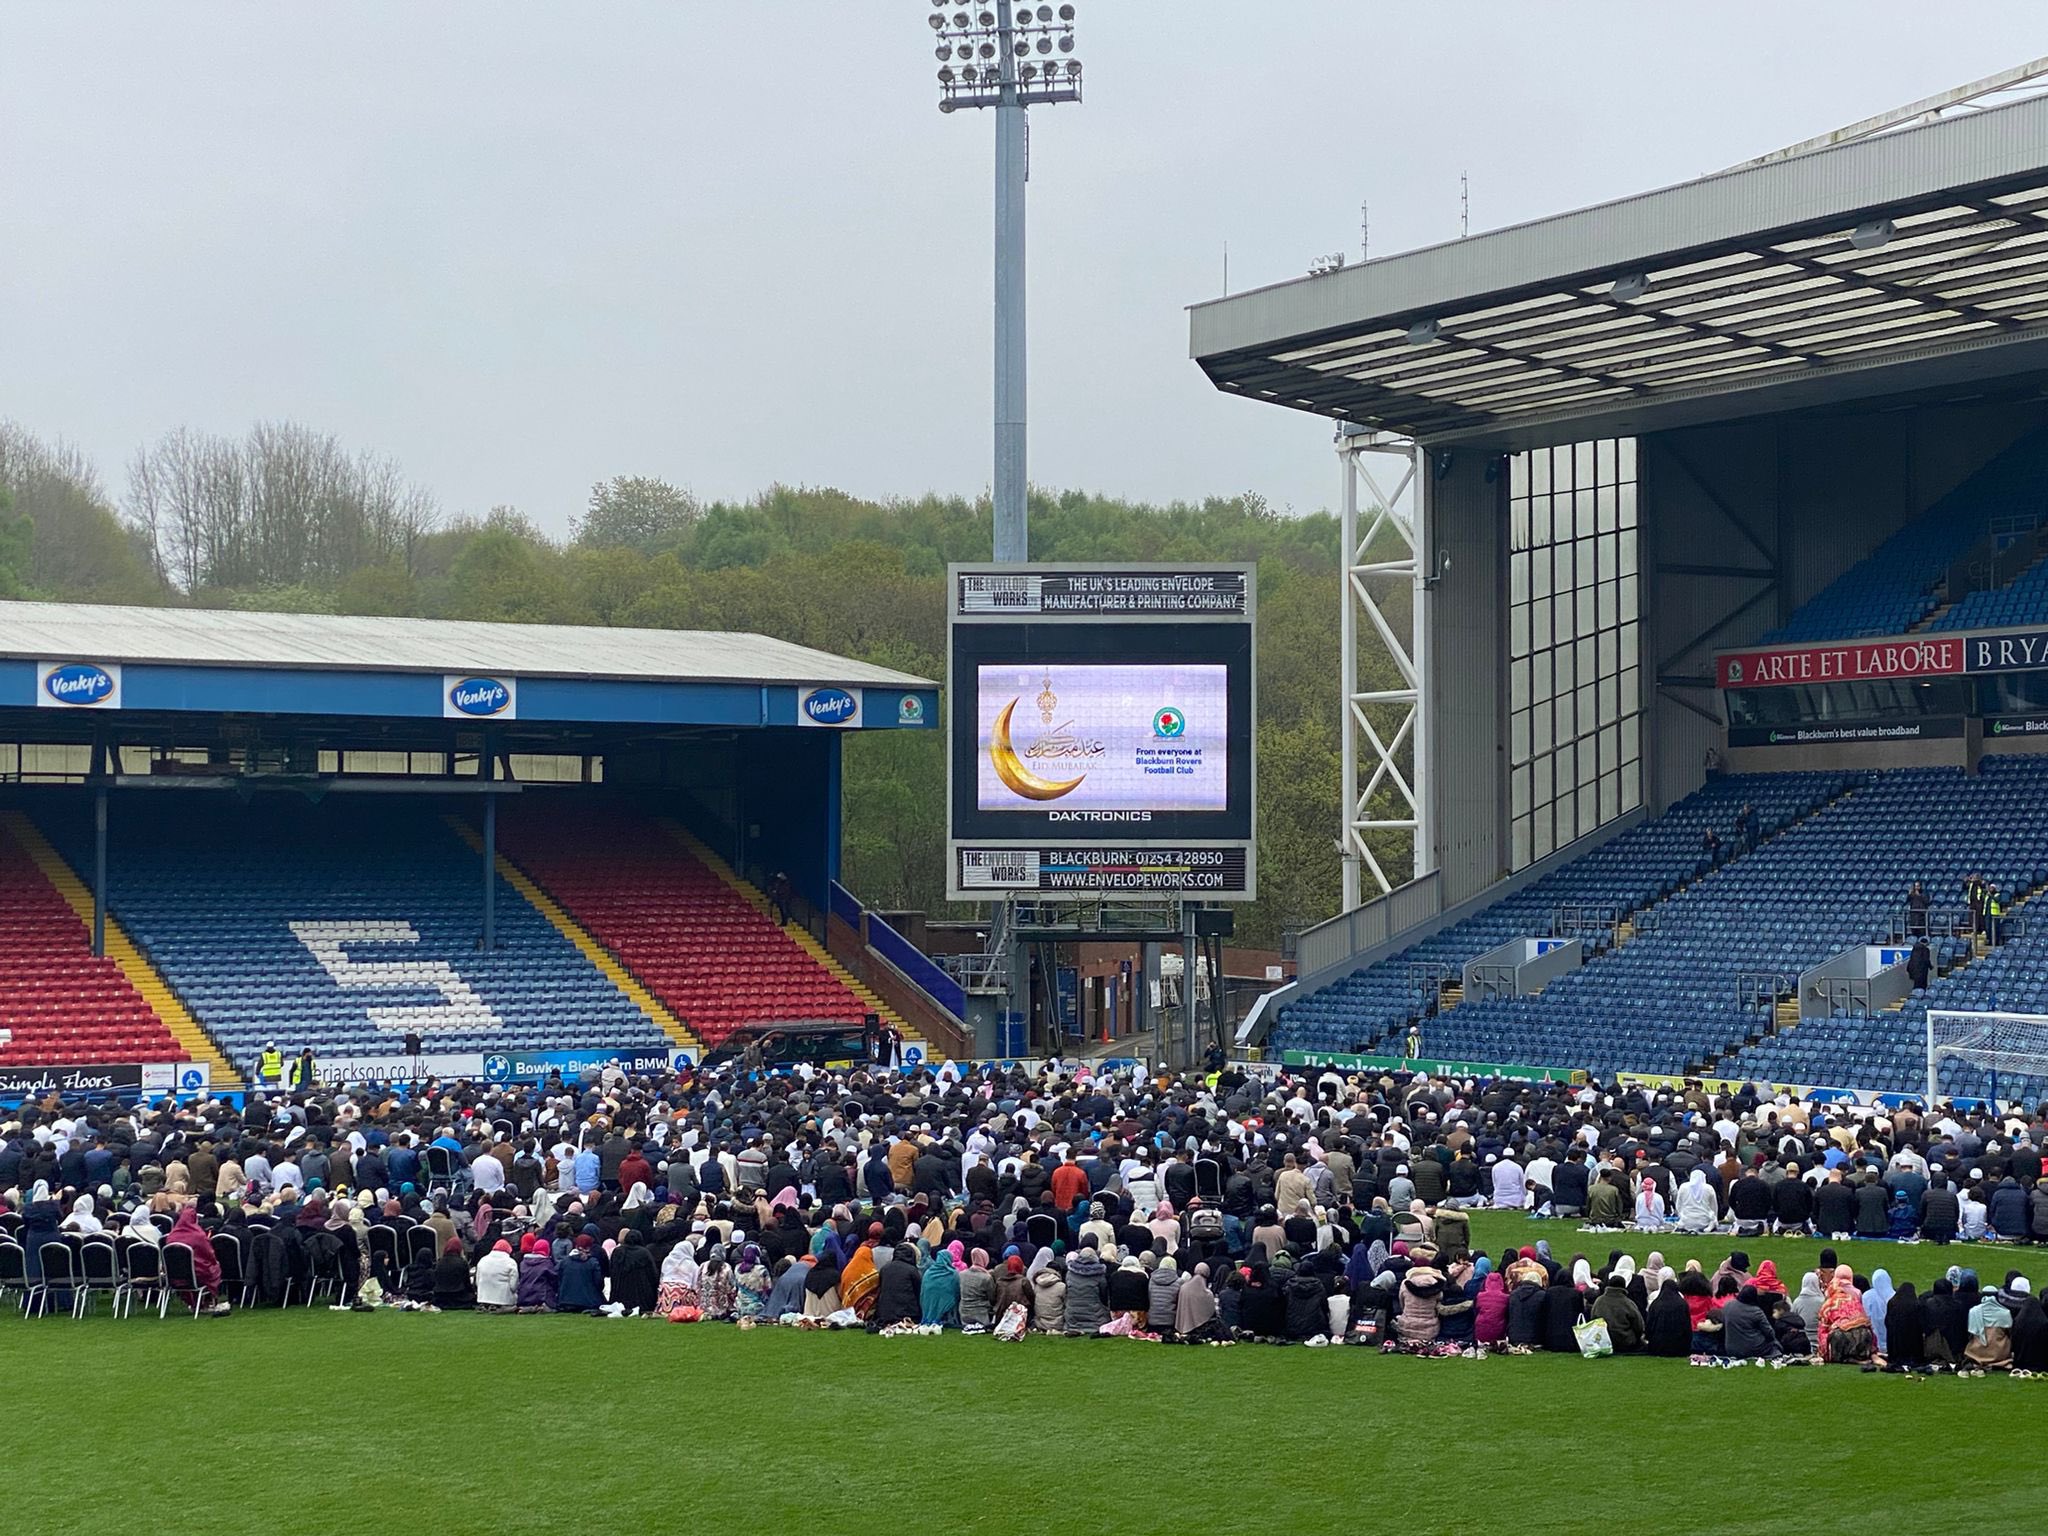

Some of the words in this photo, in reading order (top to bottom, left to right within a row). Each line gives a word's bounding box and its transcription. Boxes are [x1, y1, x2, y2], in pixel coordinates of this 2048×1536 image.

[967, 577, 984, 591] THE
[985, 577, 1028, 591] ENVELOPE
[1067, 577, 1087, 591] THE
[1089, 577, 1112, 591] UK'S
[1115, 577, 1159, 591] LEADING
[1161, 577, 1214, 591] ENVELOPE
[992, 591, 1028, 606] WORKS
[1044, 594, 1126, 609] MANUFACTURER
[1128, 594, 1136, 609] &
[1138, 594, 1185, 609] PRINTING
[1187, 594, 1238, 609] COMPANY
[1754, 653, 1812, 681] ARTE
[1820, 651, 1848, 676] ET
[1856, 644, 1953, 674] LABORE
[52, 674, 107, 695] Venky's
[456, 687, 503, 707] Venky's
[809, 697, 851, 716] Venky's
[1797, 729, 1839, 740] Blackburn's
[1840, 727, 1856, 738] best
[1857, 726, 1877, 737] value
[1878, 724, 1920, 736] broadband
[1136, 748, 1156, 756] From
[1157, 749, 1192, 757] everyone
[1136, 757, 1174, 765] Blackburn
[1176, 757, 1202, 765] Rovers
[1144, 766, 1174, 774] Football
[1176, 766, 1194, 774] Club
[1049, 811, 1152, 821] DAKTRONICS
[965, 852, 982, 866] THE
[983, 852, 1027, 866] ENVELOPE
[1050, 852, 1133, 865] BLACKBURN:
[1136, 852, 1172, 865] 01254
[1175, 852, 1223, 865] 428950
[991, 867, 1026, 882] WORKS
[1050, 873, 1223, 886] WWW.ENVELOPEWORKS.COM
[634, 1058, 668, 1070] BMW
[62, 1070, 112, 1088] Floors
